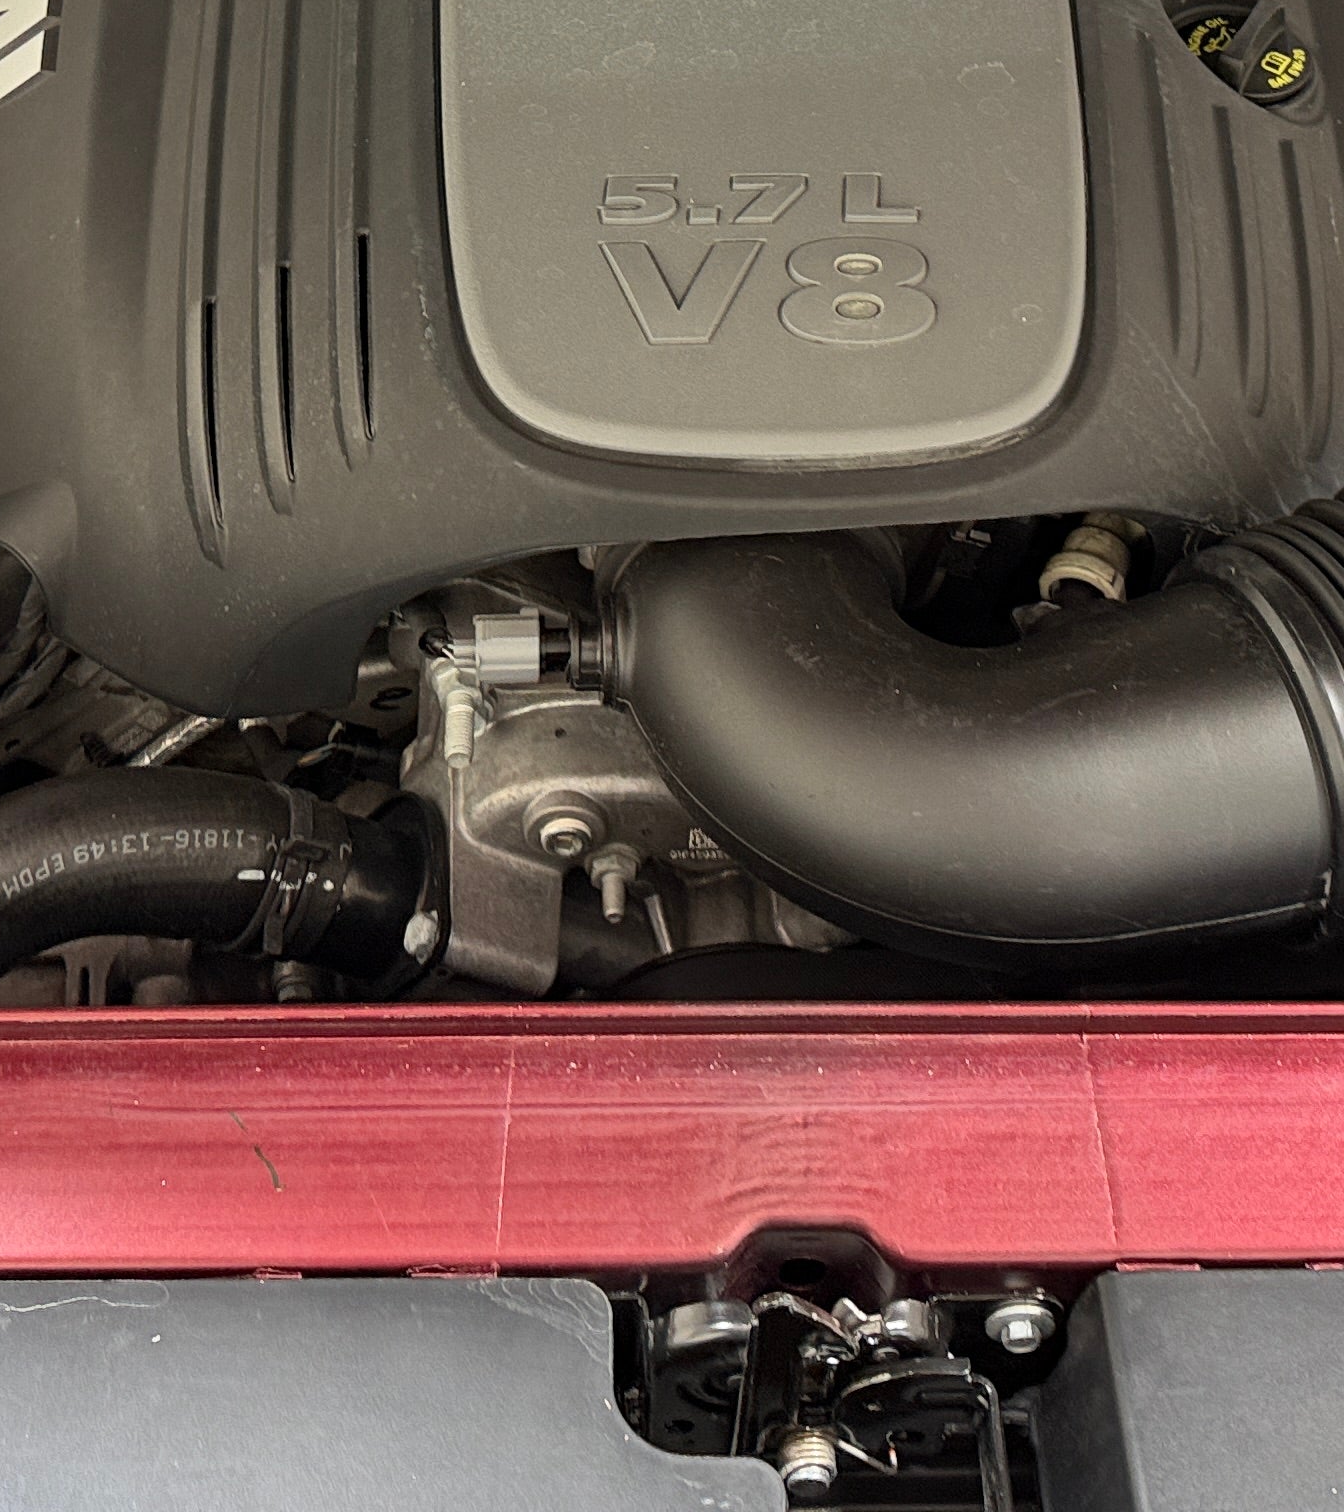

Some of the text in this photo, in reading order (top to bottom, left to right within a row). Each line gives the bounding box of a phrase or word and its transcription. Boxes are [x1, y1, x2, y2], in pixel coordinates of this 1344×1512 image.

[1205, 17, 1229, 28] OIL
[597, 236, 937, 346] V8
[1, 854, 65, 899] EPDM
